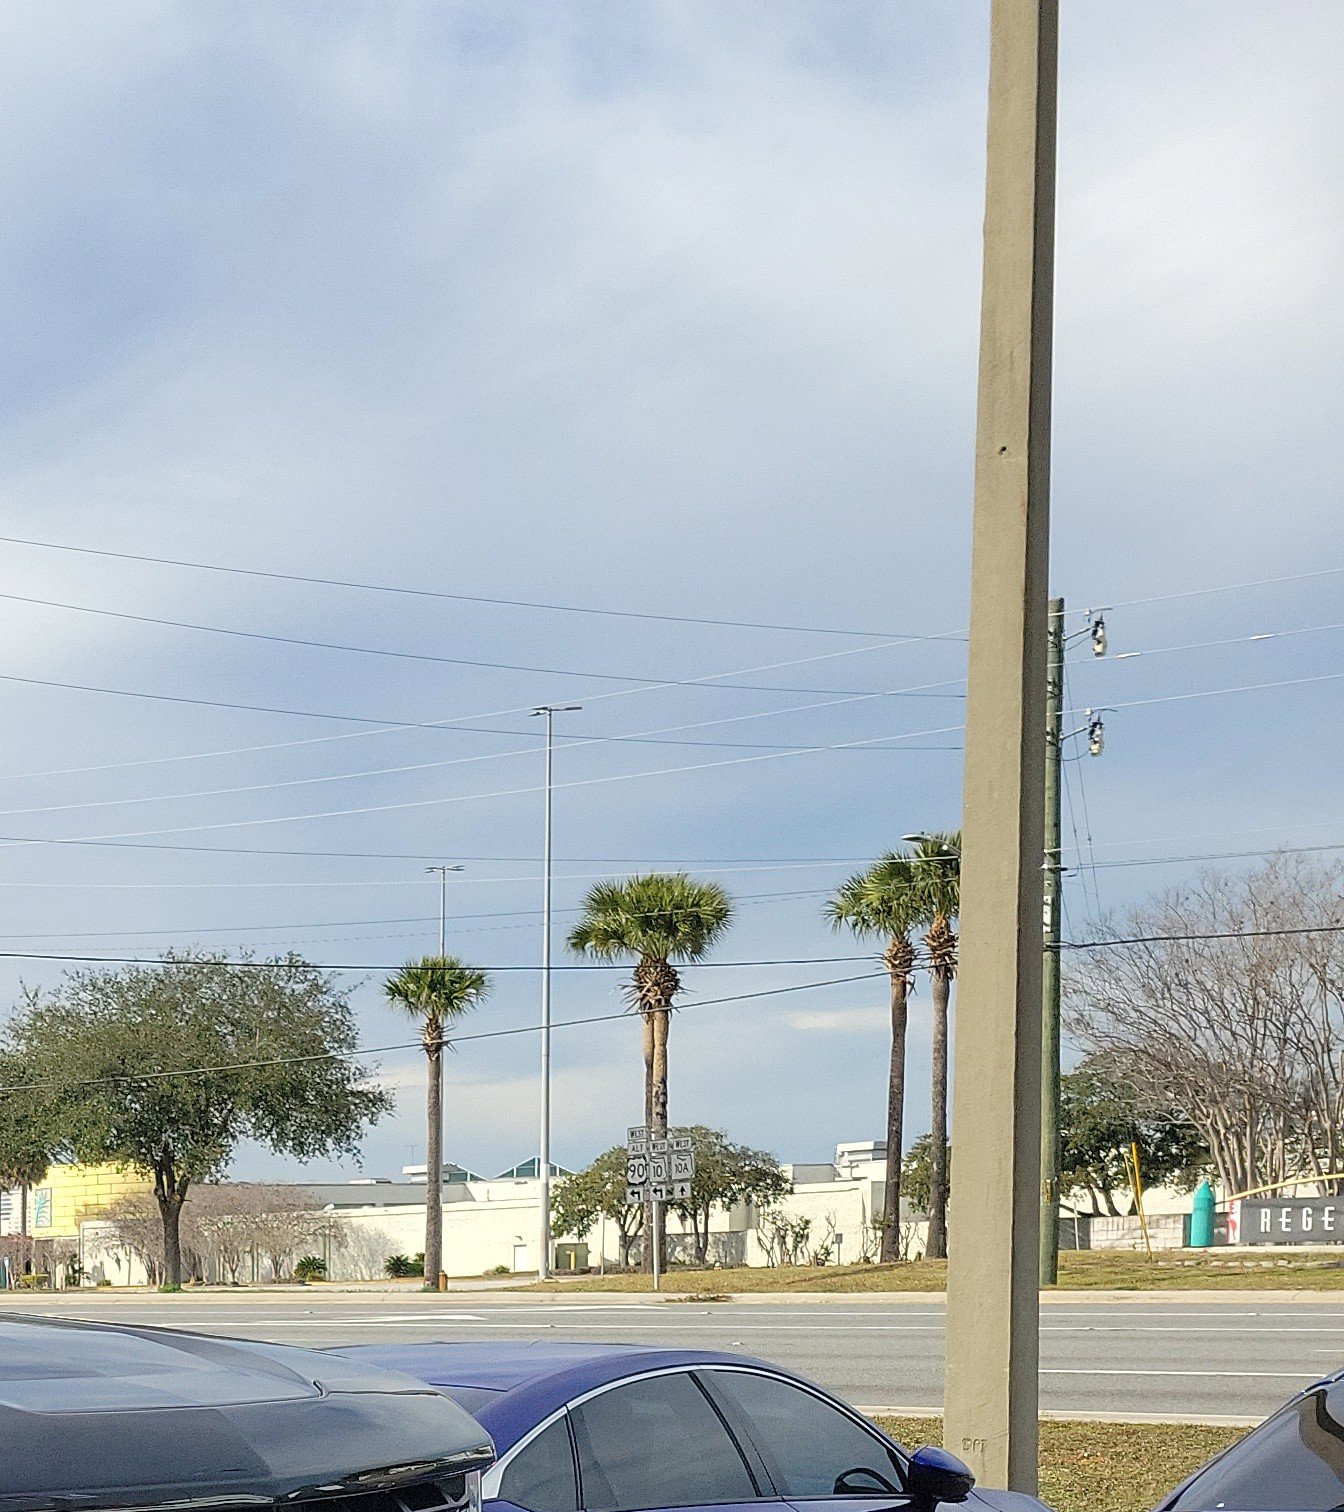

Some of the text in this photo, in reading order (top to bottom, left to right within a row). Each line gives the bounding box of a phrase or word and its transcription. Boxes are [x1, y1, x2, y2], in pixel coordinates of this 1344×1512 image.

[630, 1129, 645, 1138] WEST
[631, 1144, 643, 1152] ALT
[652, 1142, 666, 1150] WEST
[675, 1139, 690, 1148] WEST
[628, 1163, 645, 1178] 90
[652, 1164, 663, 1178] 10
[674, 1162, 689, 1174] 10A
[1260, 1206, 1335, 1233] REGE
